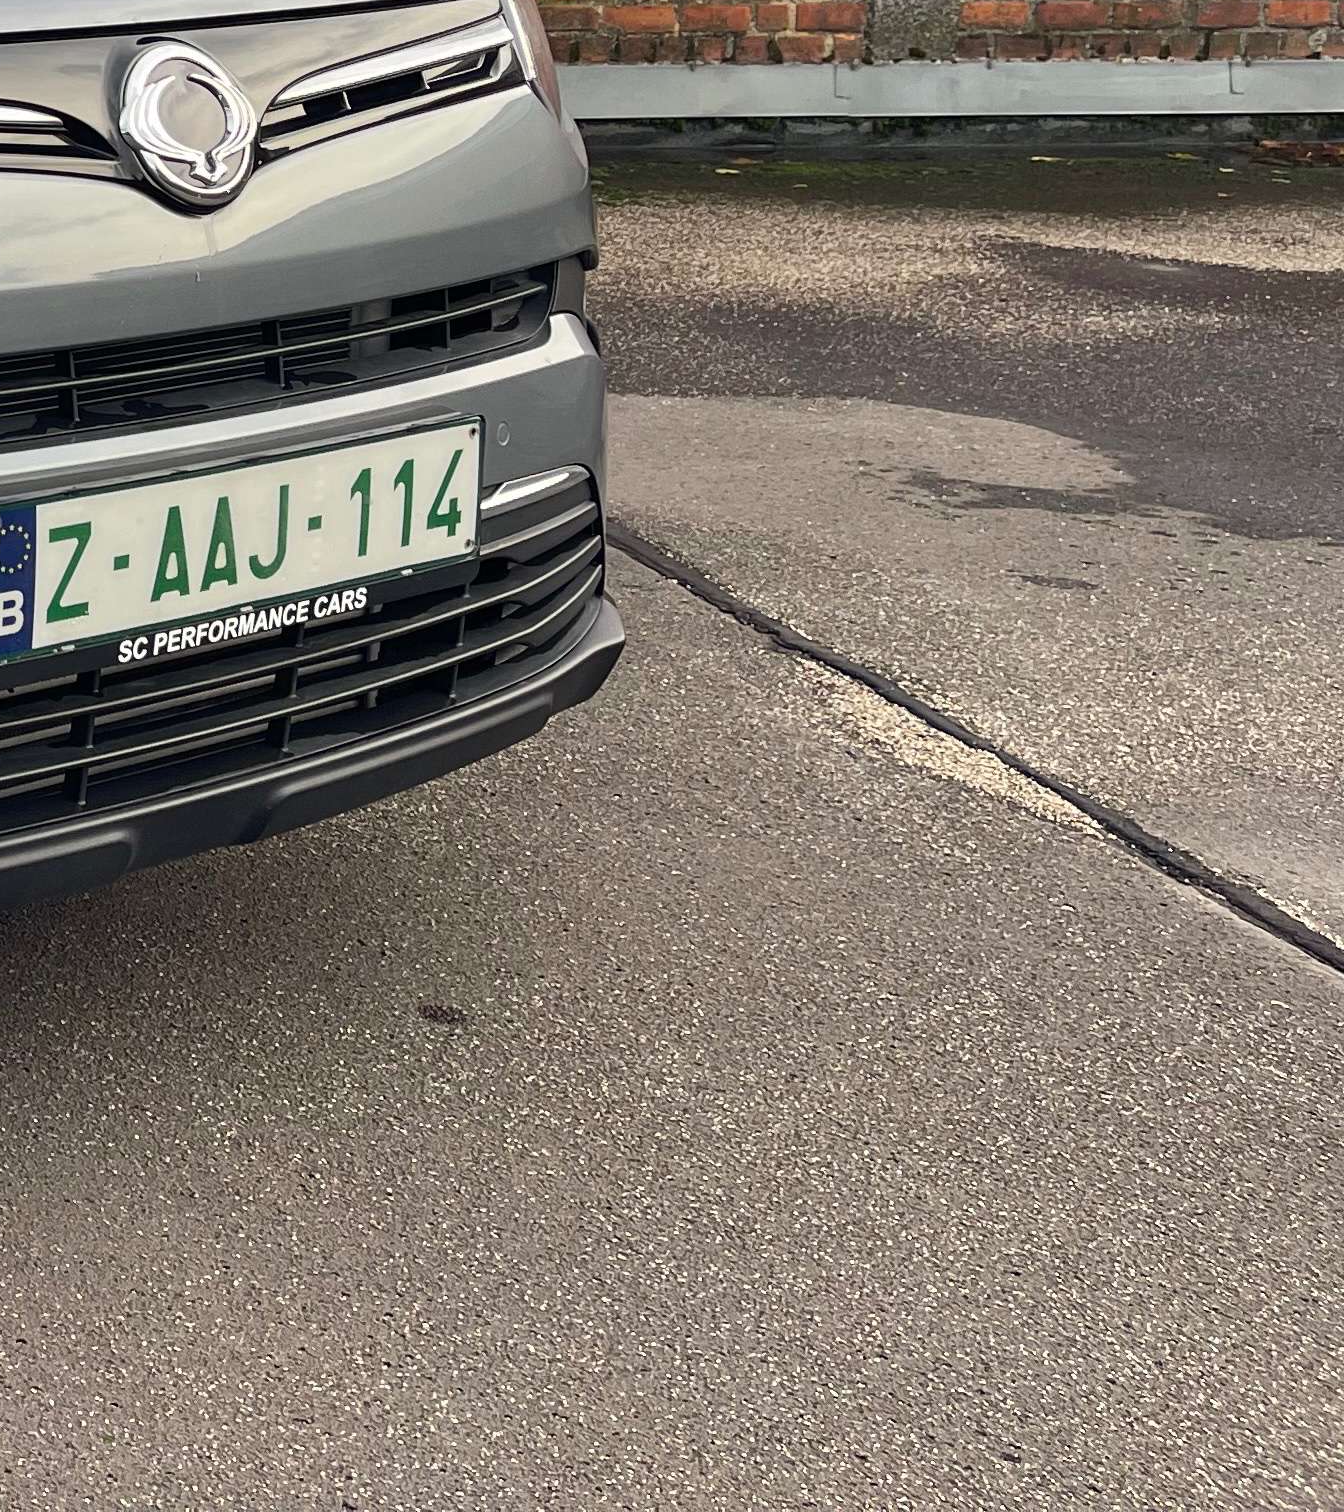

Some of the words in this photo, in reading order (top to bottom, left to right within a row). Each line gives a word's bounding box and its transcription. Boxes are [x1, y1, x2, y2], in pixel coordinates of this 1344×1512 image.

[45, 449, 465, 625] Z-AAJ-114
[117, 636, 148, 664] SC
[153, 599, 311, 656] PERFORMANCE
[313, 586, 368, 619] CARS
